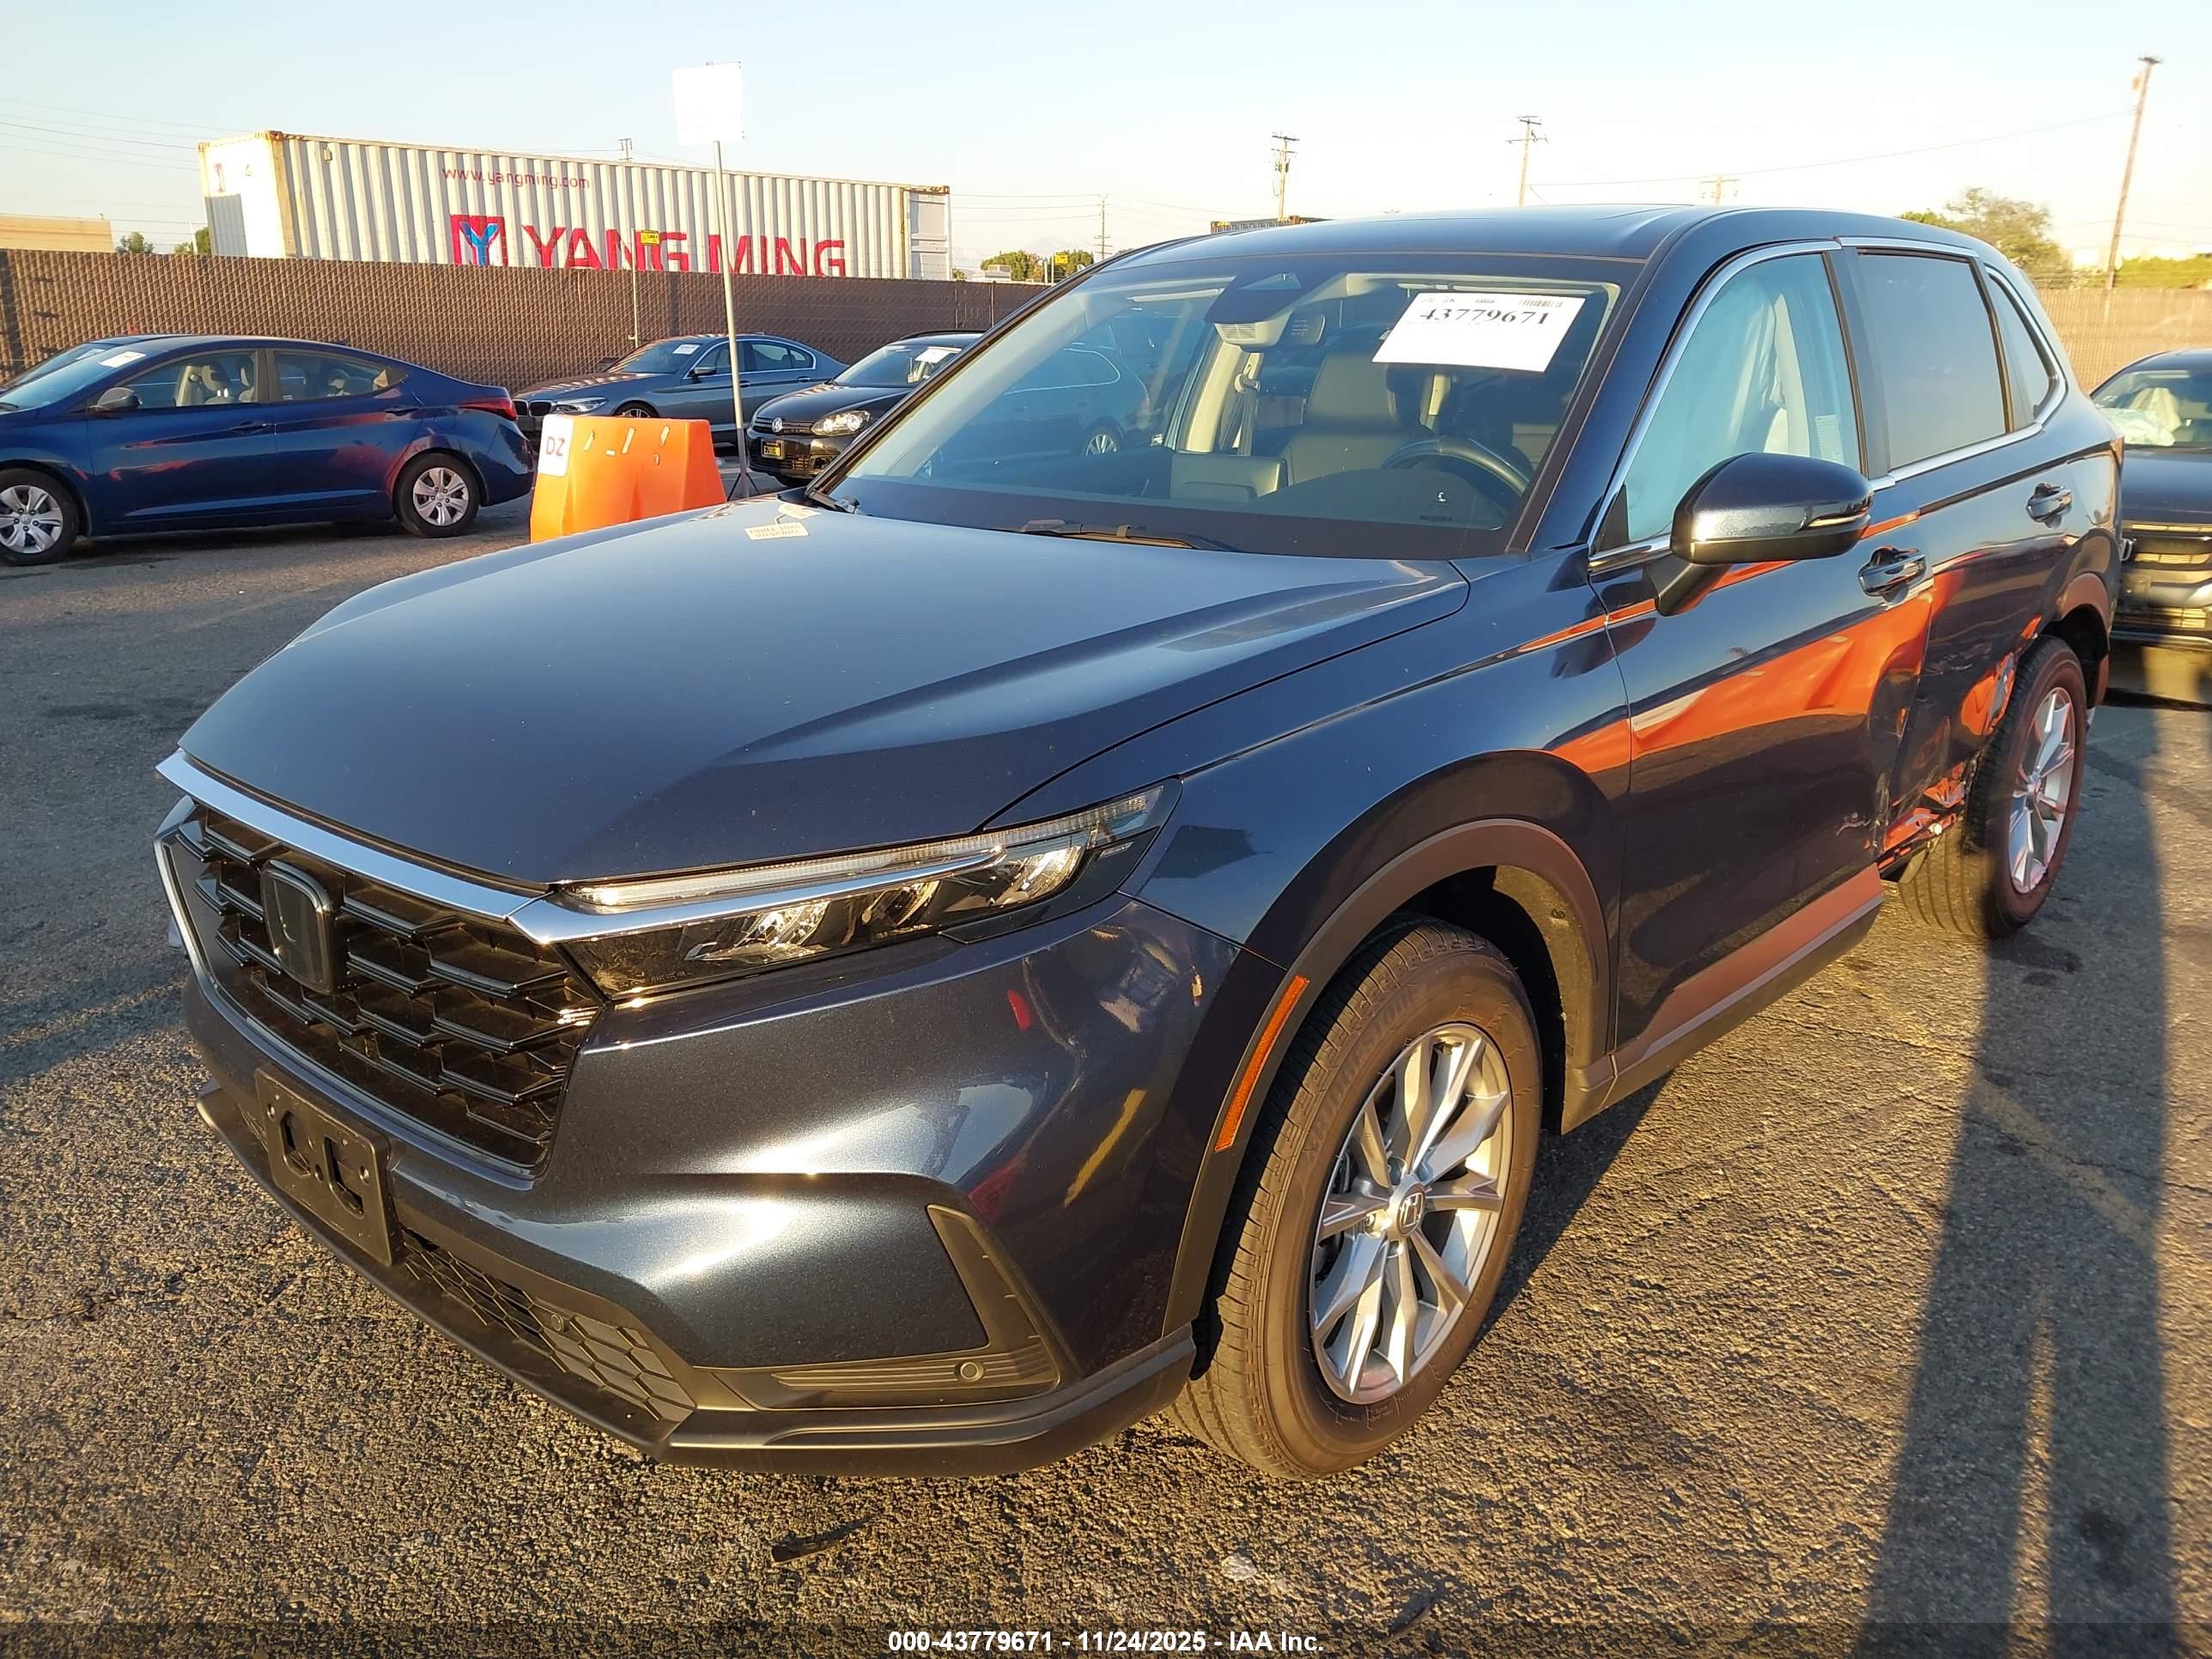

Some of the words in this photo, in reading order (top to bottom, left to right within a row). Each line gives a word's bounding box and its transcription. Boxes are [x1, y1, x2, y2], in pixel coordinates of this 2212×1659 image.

[442, 167, 590, 189] www.yangming.com
[521, 224, 688, 273] YANG
[708, 234, 847, 277] MING
[1419, 307, 1549, 325] 43779671
